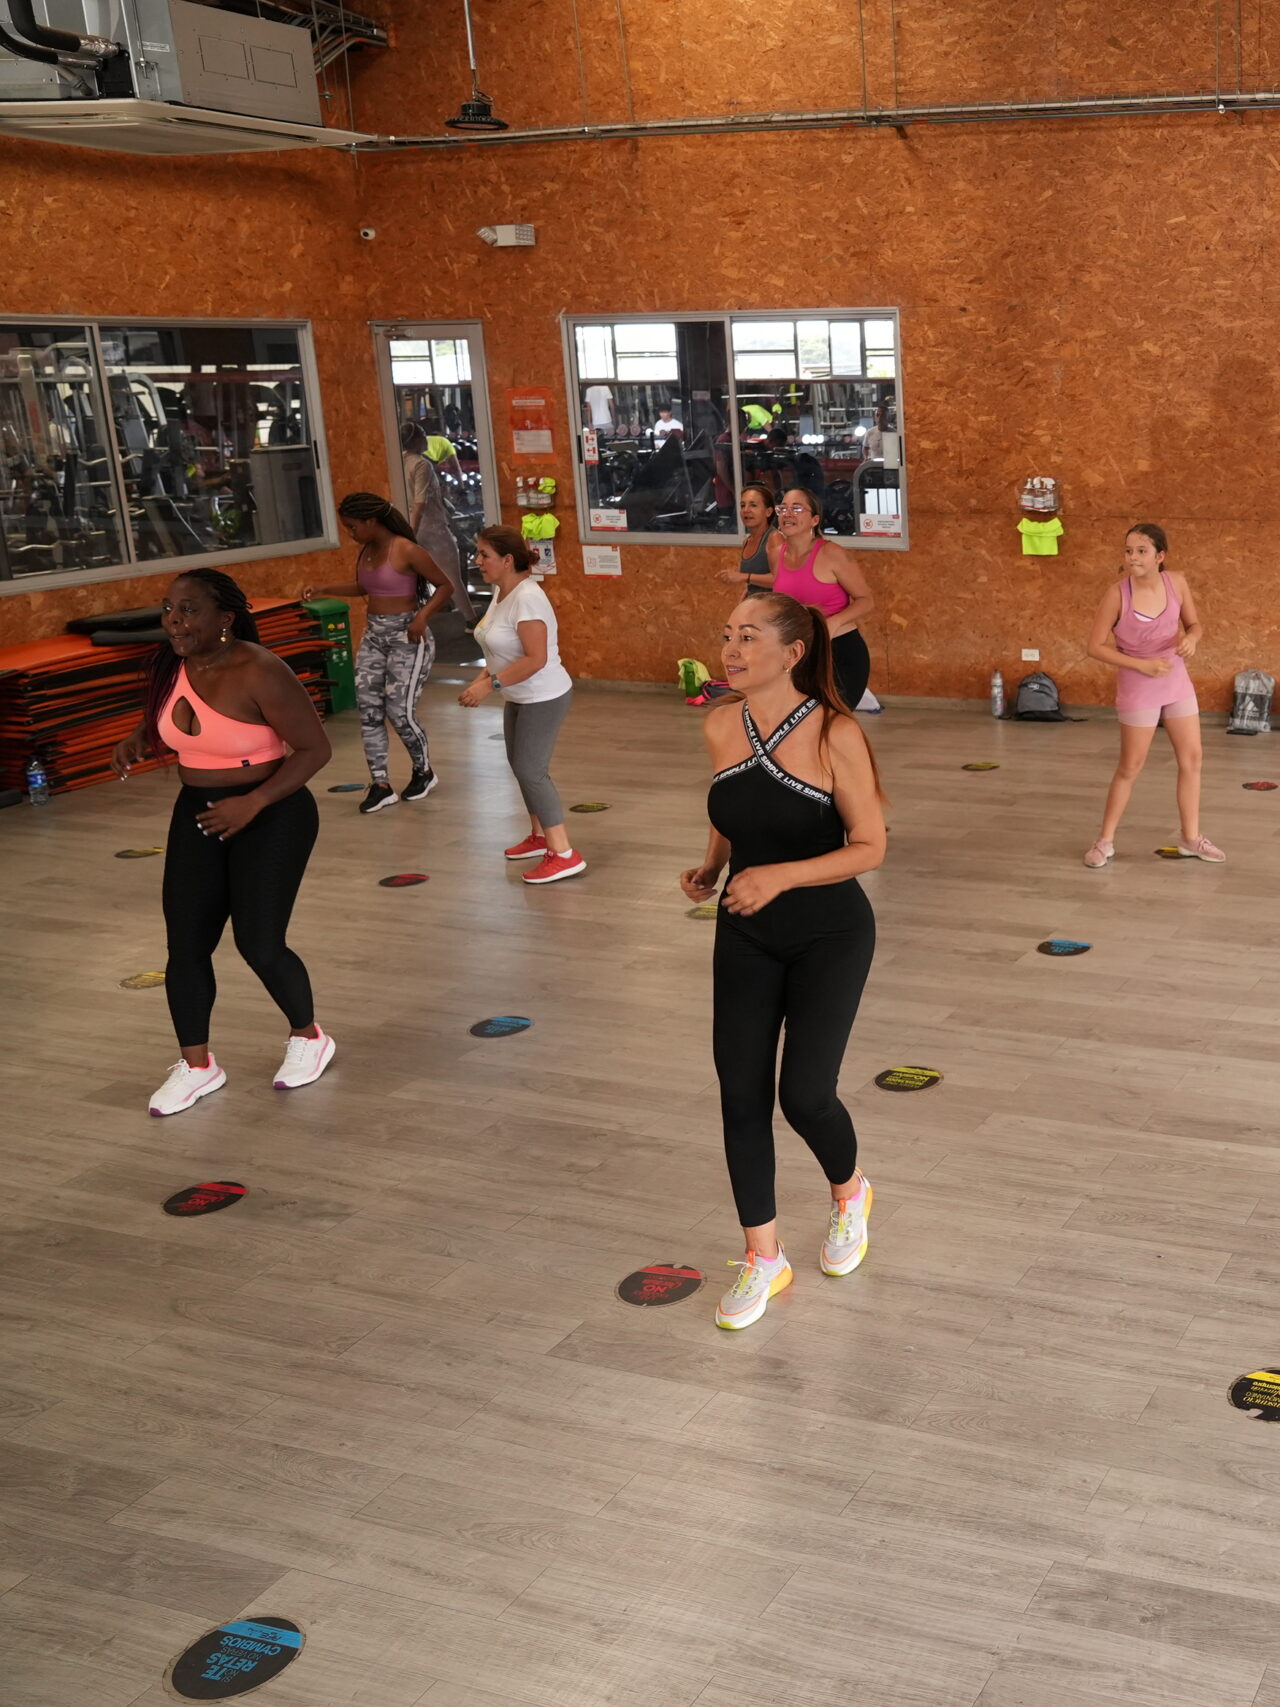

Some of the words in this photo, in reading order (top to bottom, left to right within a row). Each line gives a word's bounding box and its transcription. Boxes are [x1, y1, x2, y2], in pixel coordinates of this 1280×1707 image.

[765, 723, 790, 750] SIMPLE
[789, 705, 809, 723] LIVE
[752, 737, 765, 755] LIVE
[761, 755, 785, 778] SIMPLE
[783, 776, 805, 791] LIVE
[802, 786, 829, 802] SIMPLE
[642, 1284, 667, 1293] NO
[219, 1635, 282, 1656] CAMBIOS
[201, 1665, 228, 1681] TE
[206, 1652, 258, 1673] RETAS
